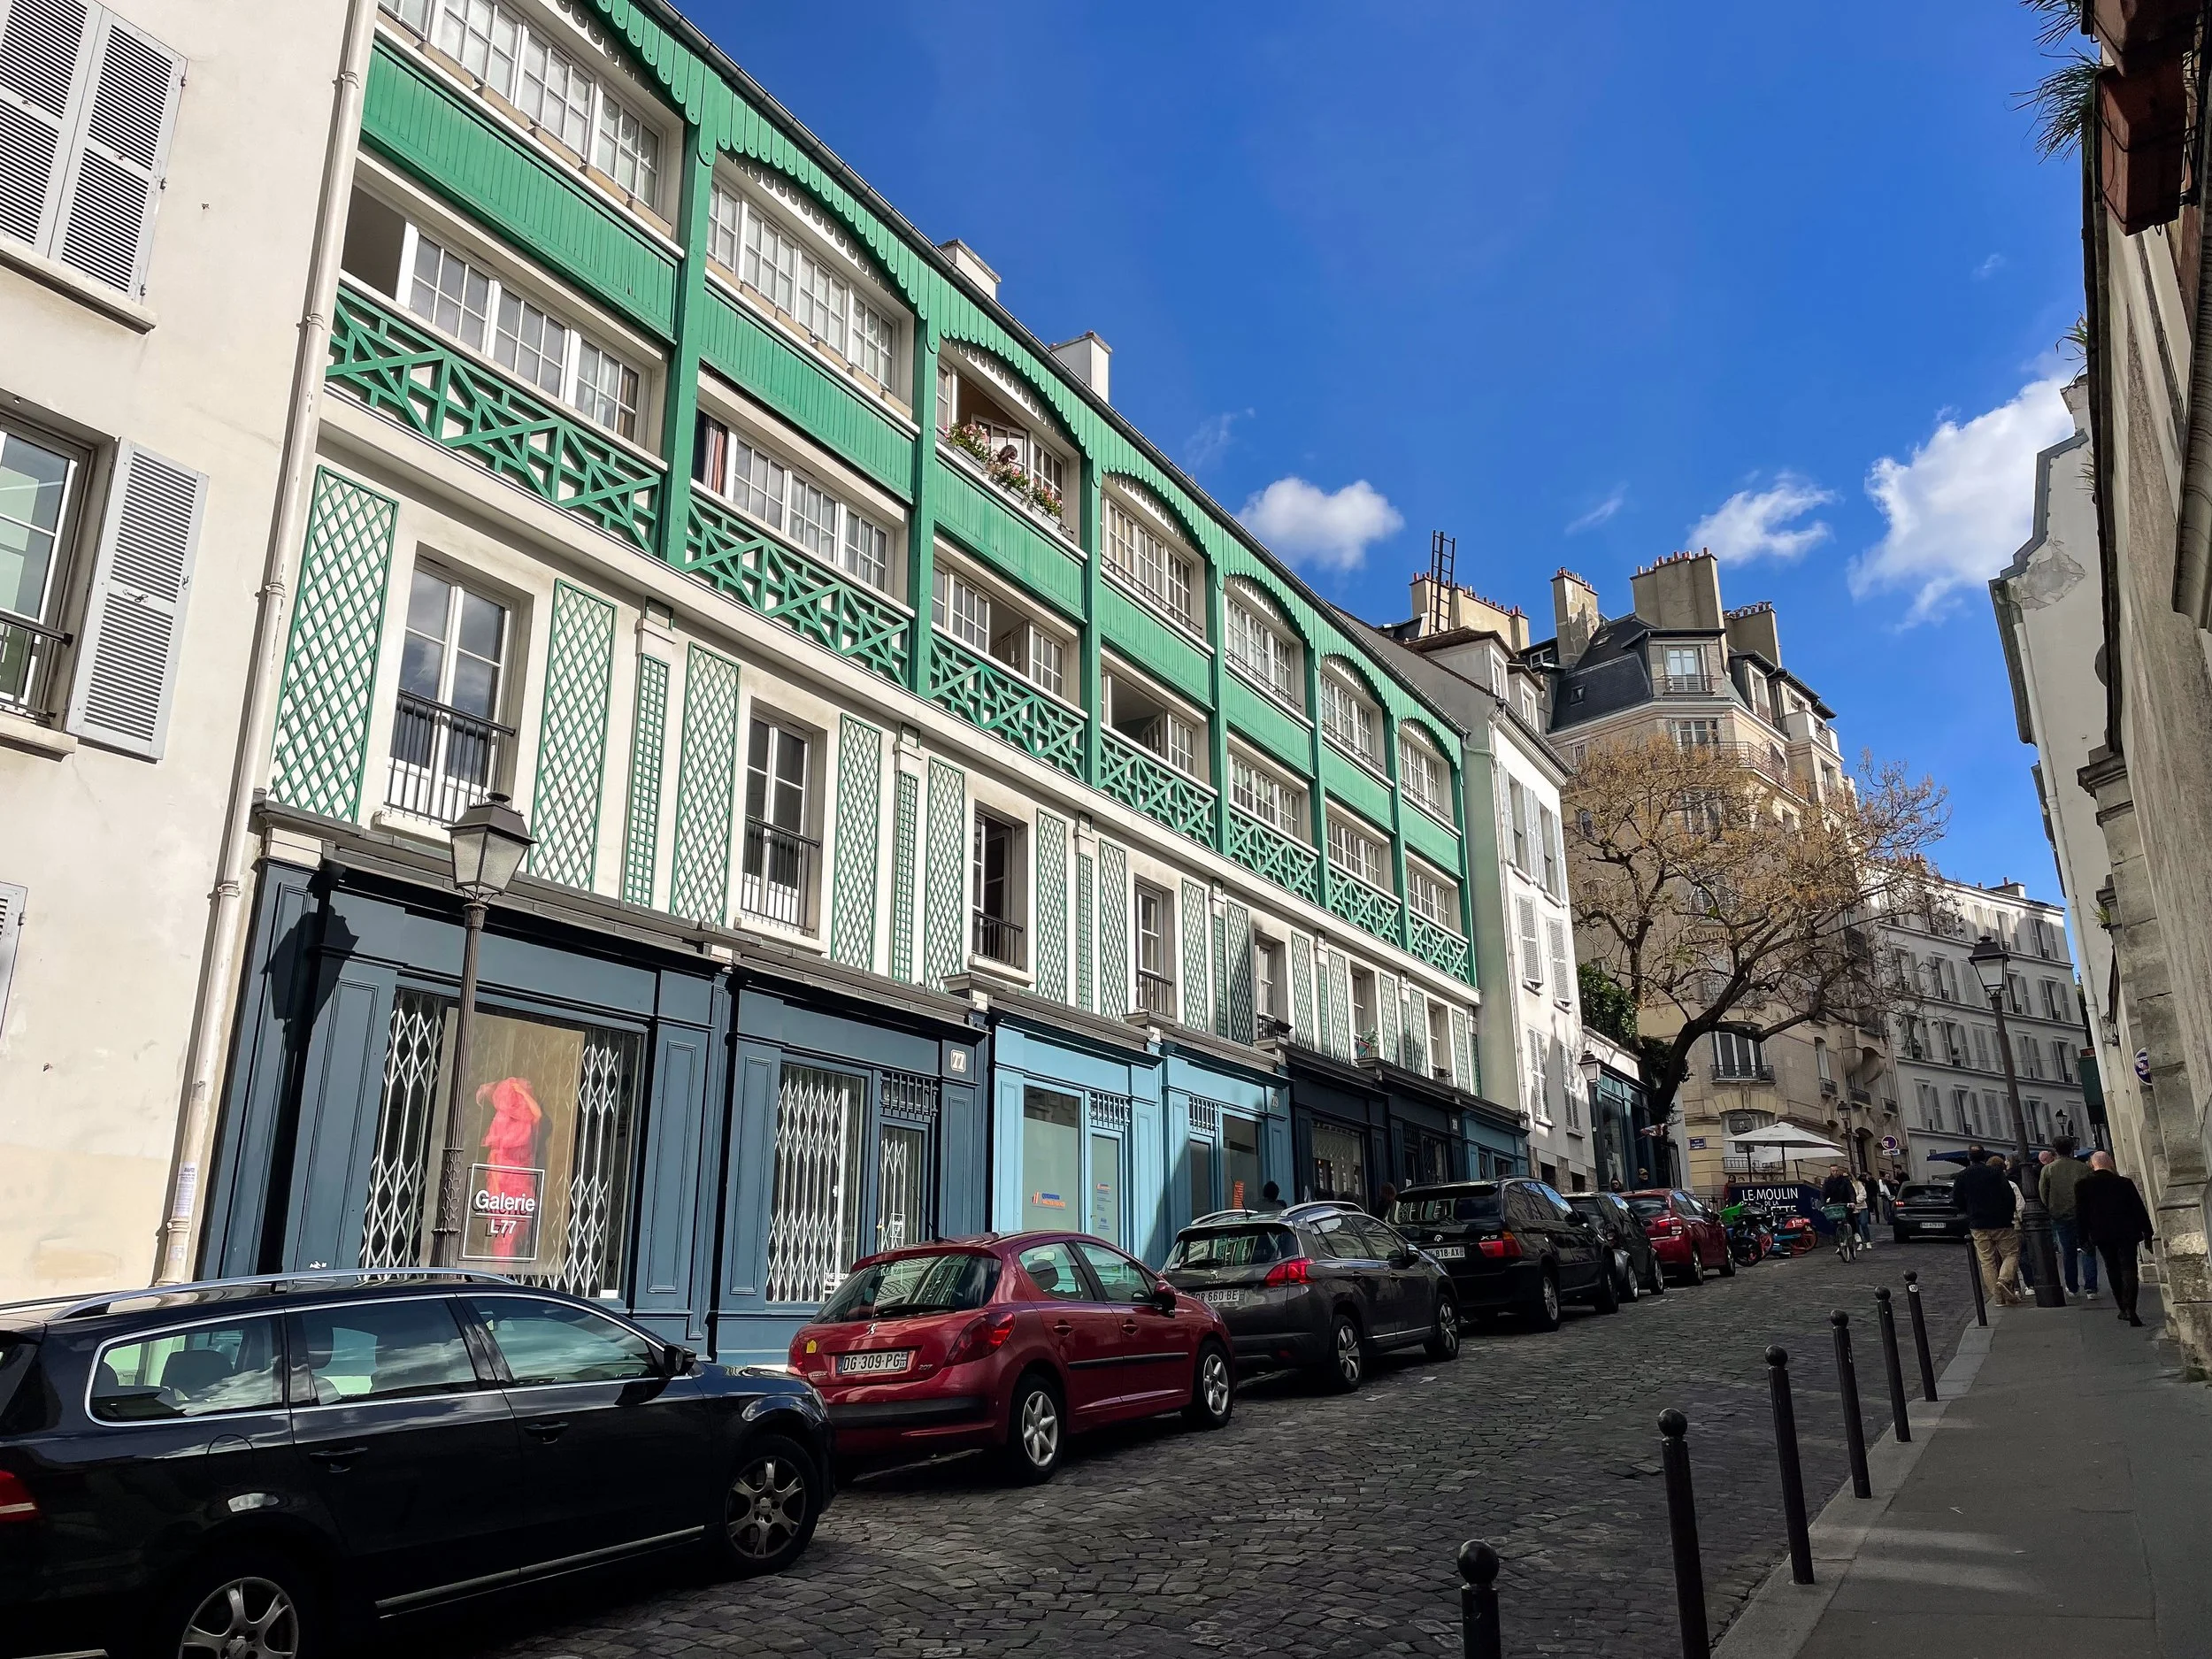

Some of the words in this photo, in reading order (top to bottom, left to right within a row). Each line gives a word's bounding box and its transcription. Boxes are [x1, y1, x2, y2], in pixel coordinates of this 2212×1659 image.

[952, 1052, 965, 1071] 77
[475, 1189, 535, 1212] Galerie
[1742, 1189, 1755, 1201] LE
[1756, 1187, 1799, 1201] MOULIN
[489, 1218, 517, 1234] L77
[842, 1353, 901, 1371] DG-309-PG
